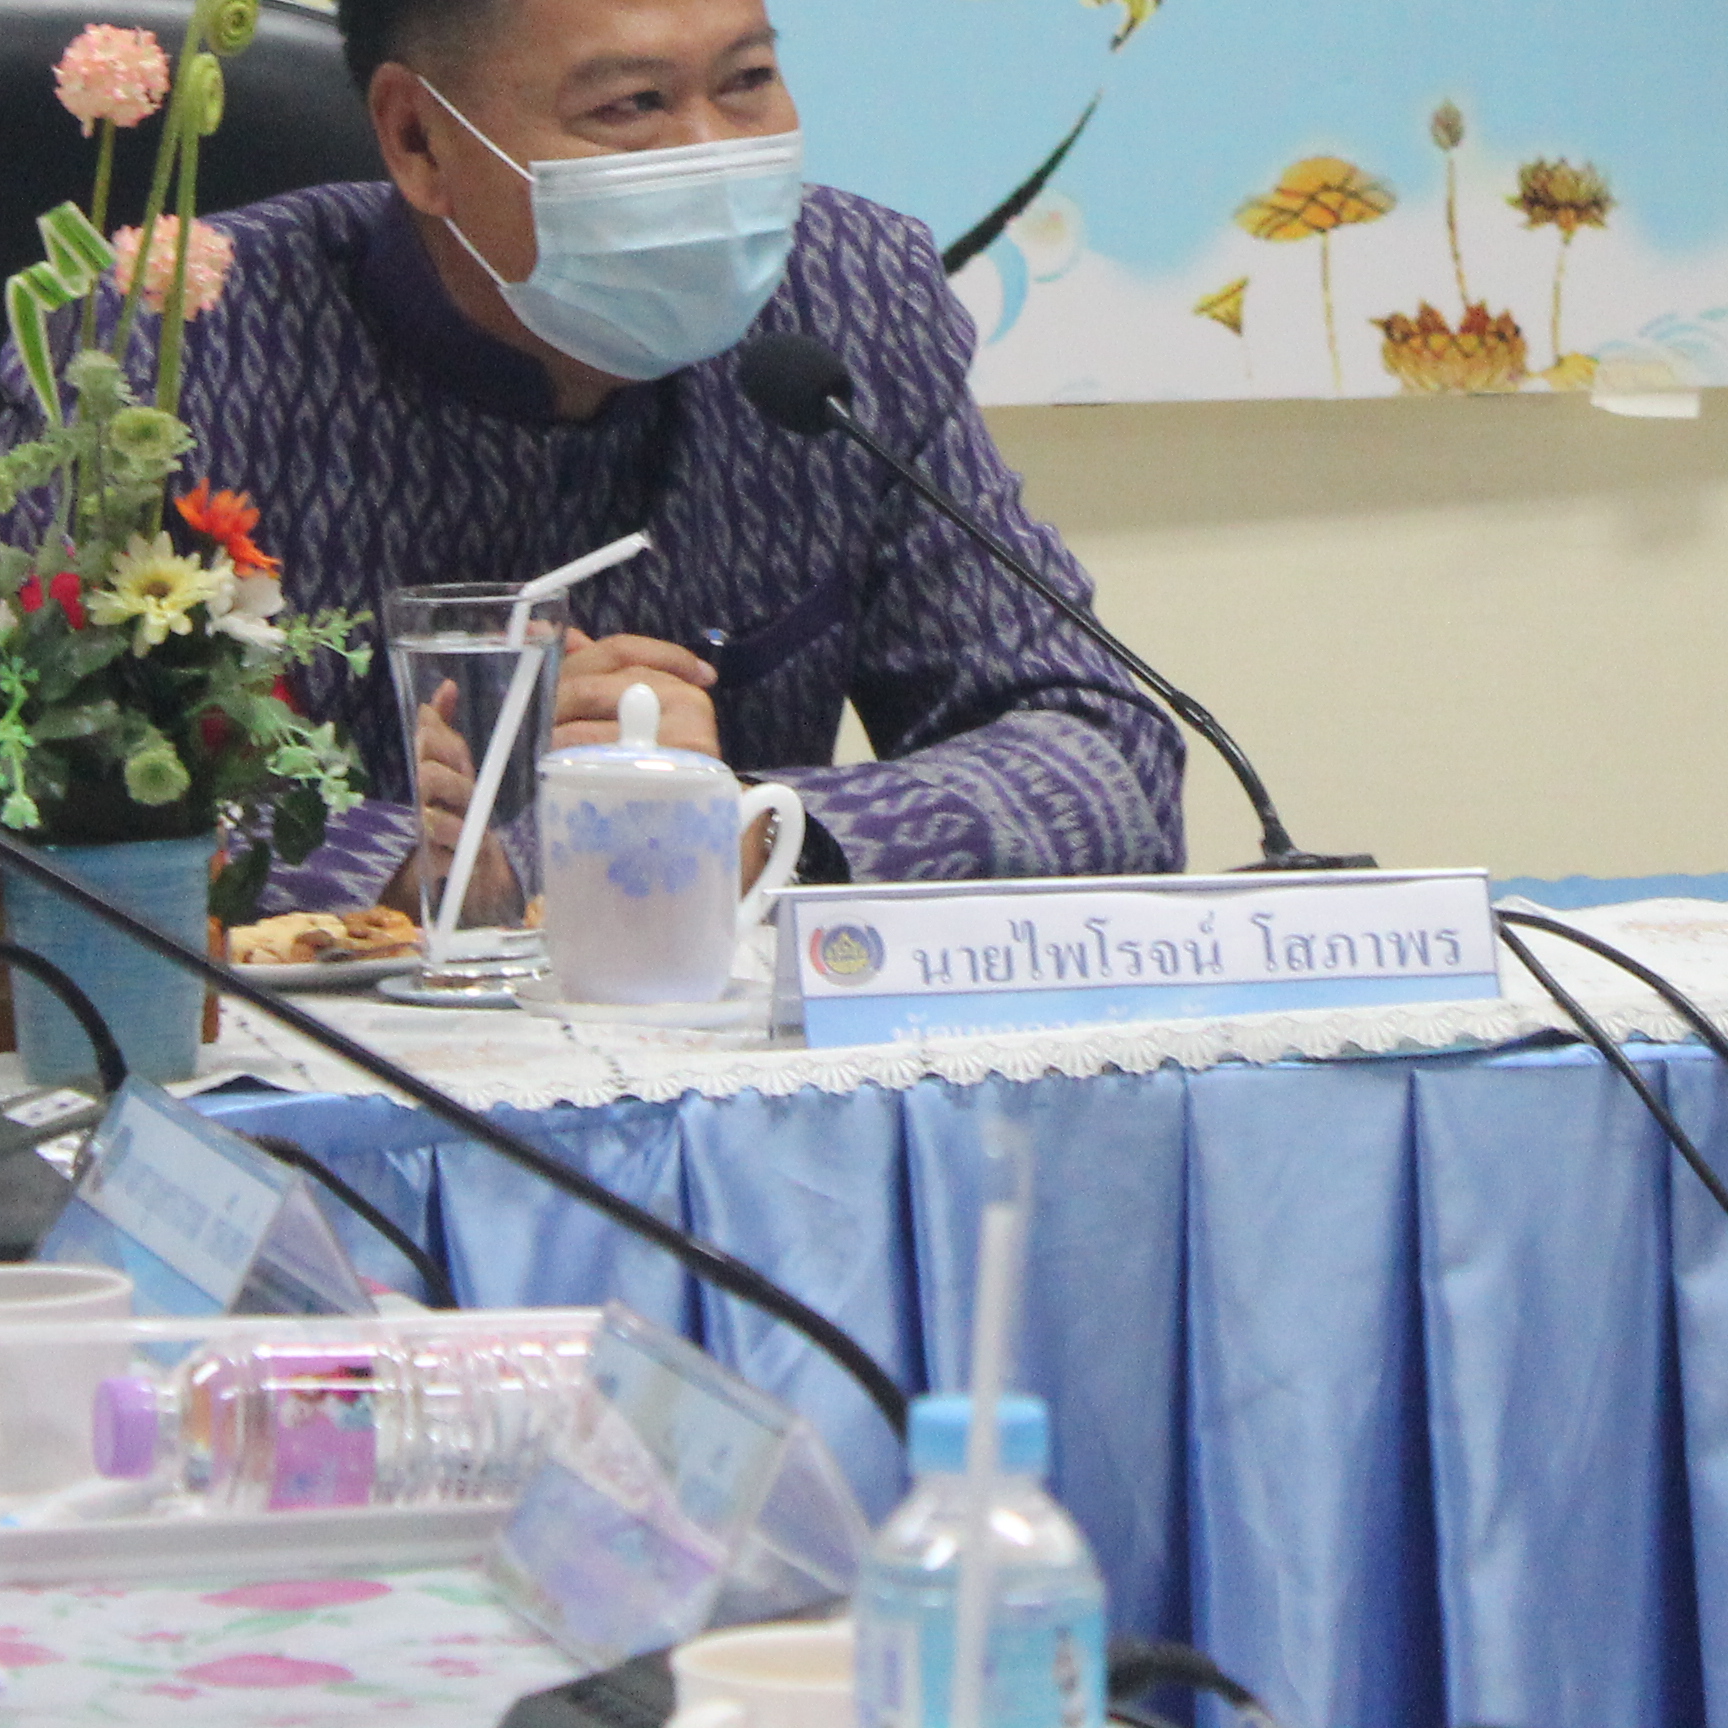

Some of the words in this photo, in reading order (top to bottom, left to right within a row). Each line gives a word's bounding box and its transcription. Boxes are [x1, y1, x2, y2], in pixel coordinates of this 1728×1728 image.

[913, 912, 1224, 985] นายไพโรจน์
[1249, 913, 1464, 976] โสภาพร
